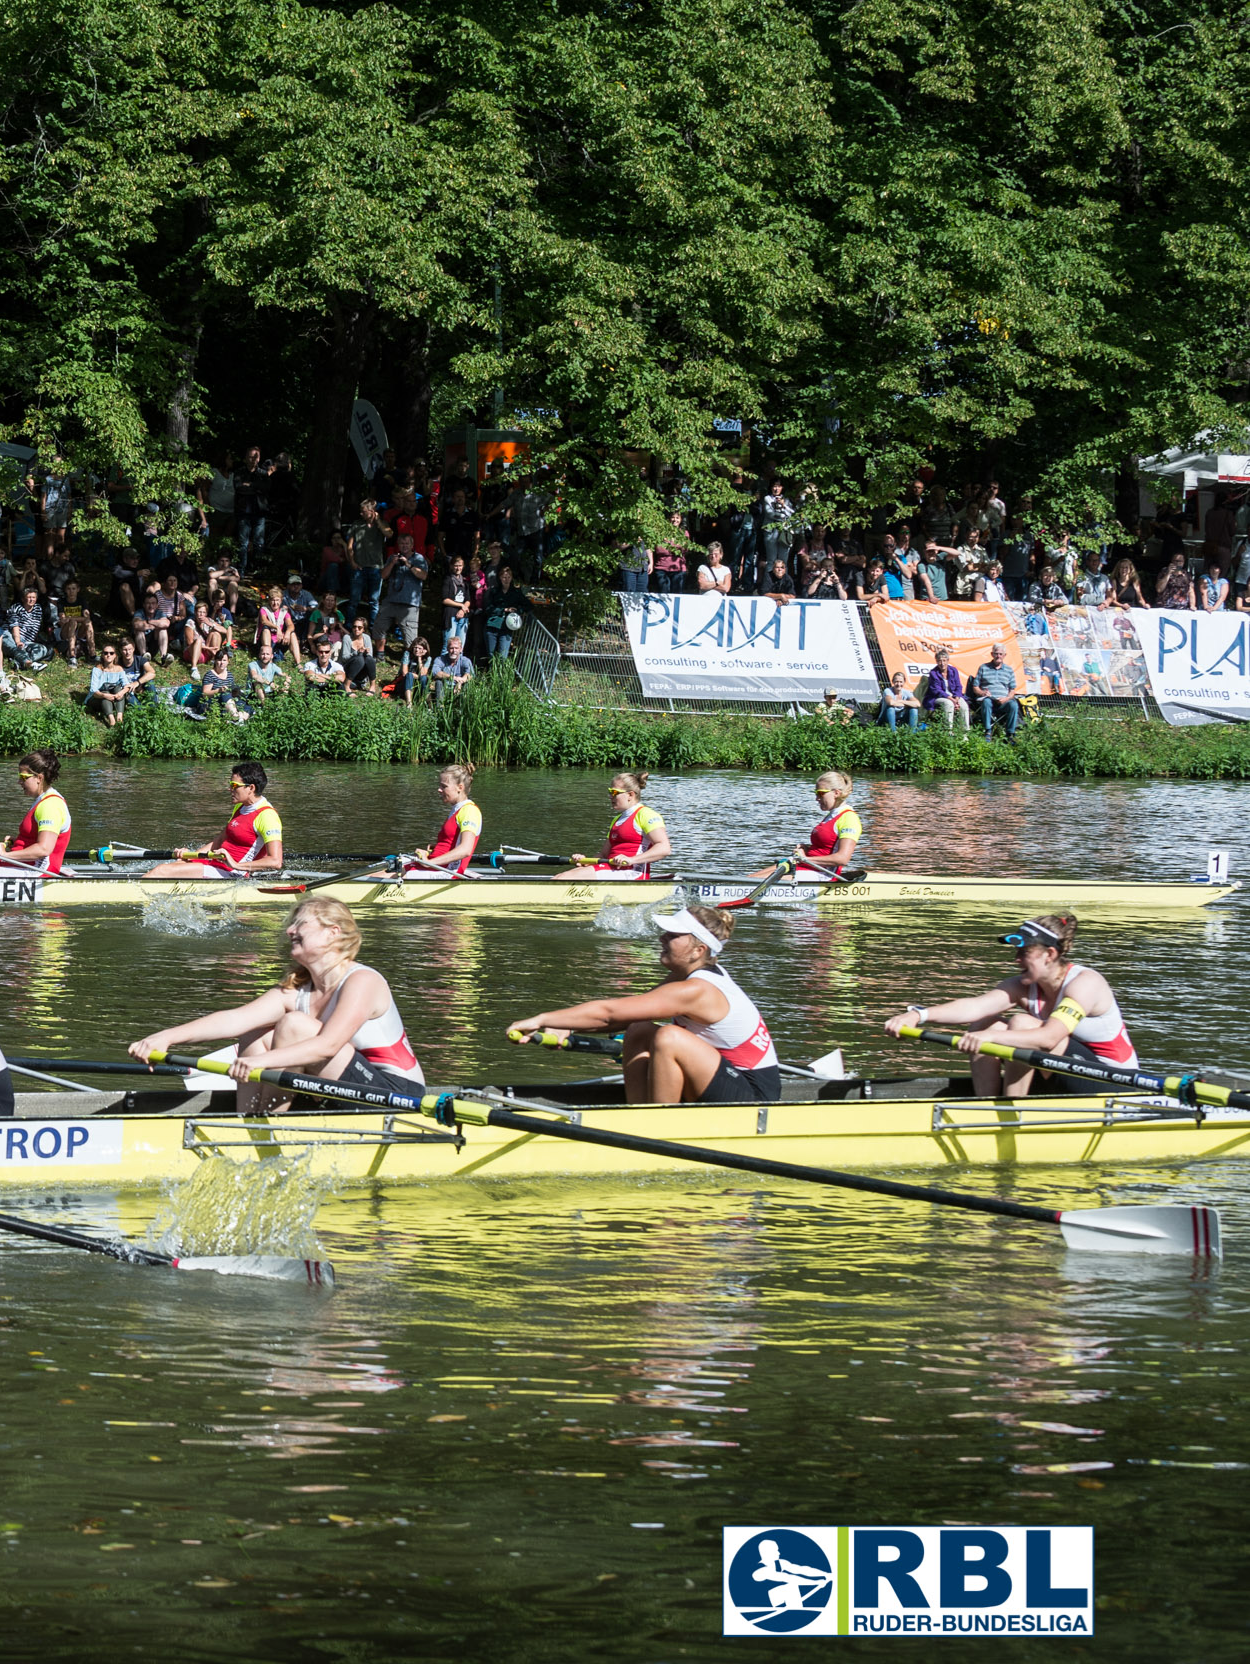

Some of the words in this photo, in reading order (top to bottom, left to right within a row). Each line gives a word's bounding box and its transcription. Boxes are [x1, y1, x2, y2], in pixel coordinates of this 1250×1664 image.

[640, 596, 821, 653] PLANAT
[912, 612, 946, 622] miete
[950, 612, 977, 623] alles
[841, 603, 865, 672] www.planat.de
[894, 625, 950, 639] benötigte
[953, 626, 1003, 639] Material
[898, 640, 918, 652] bei
[1158, 616, 1250, 680] PLA
[645, 657, 707, 669] consulting
[720, 659, 773, 669] software
[786, 661, 829, 671] service
[1164, 688, 1230, 700] consulting
[1212, 854, 1220, 873] 1
[373, 883, 406, 898] Melitta
[563, 884, 595, 898] Melitta
[689, 885, 721, 897] RBL
[823, 887, 832, 896] Z
[833, 887, 849, 896] BS
[852, 886, 871, 896] 001
[899, 886, 921, 896] Erich
[750, 1026, 770, 1051] RC
[1137, 1076, 1160, 1089] RBL
[292, 1078, 323, 1094] STARK.
[323, 1085, 365, 1101] SCHNELL.
[365, 1092, 386, 1105] GUT.
[392, 1096, 416, 1110] RBL
